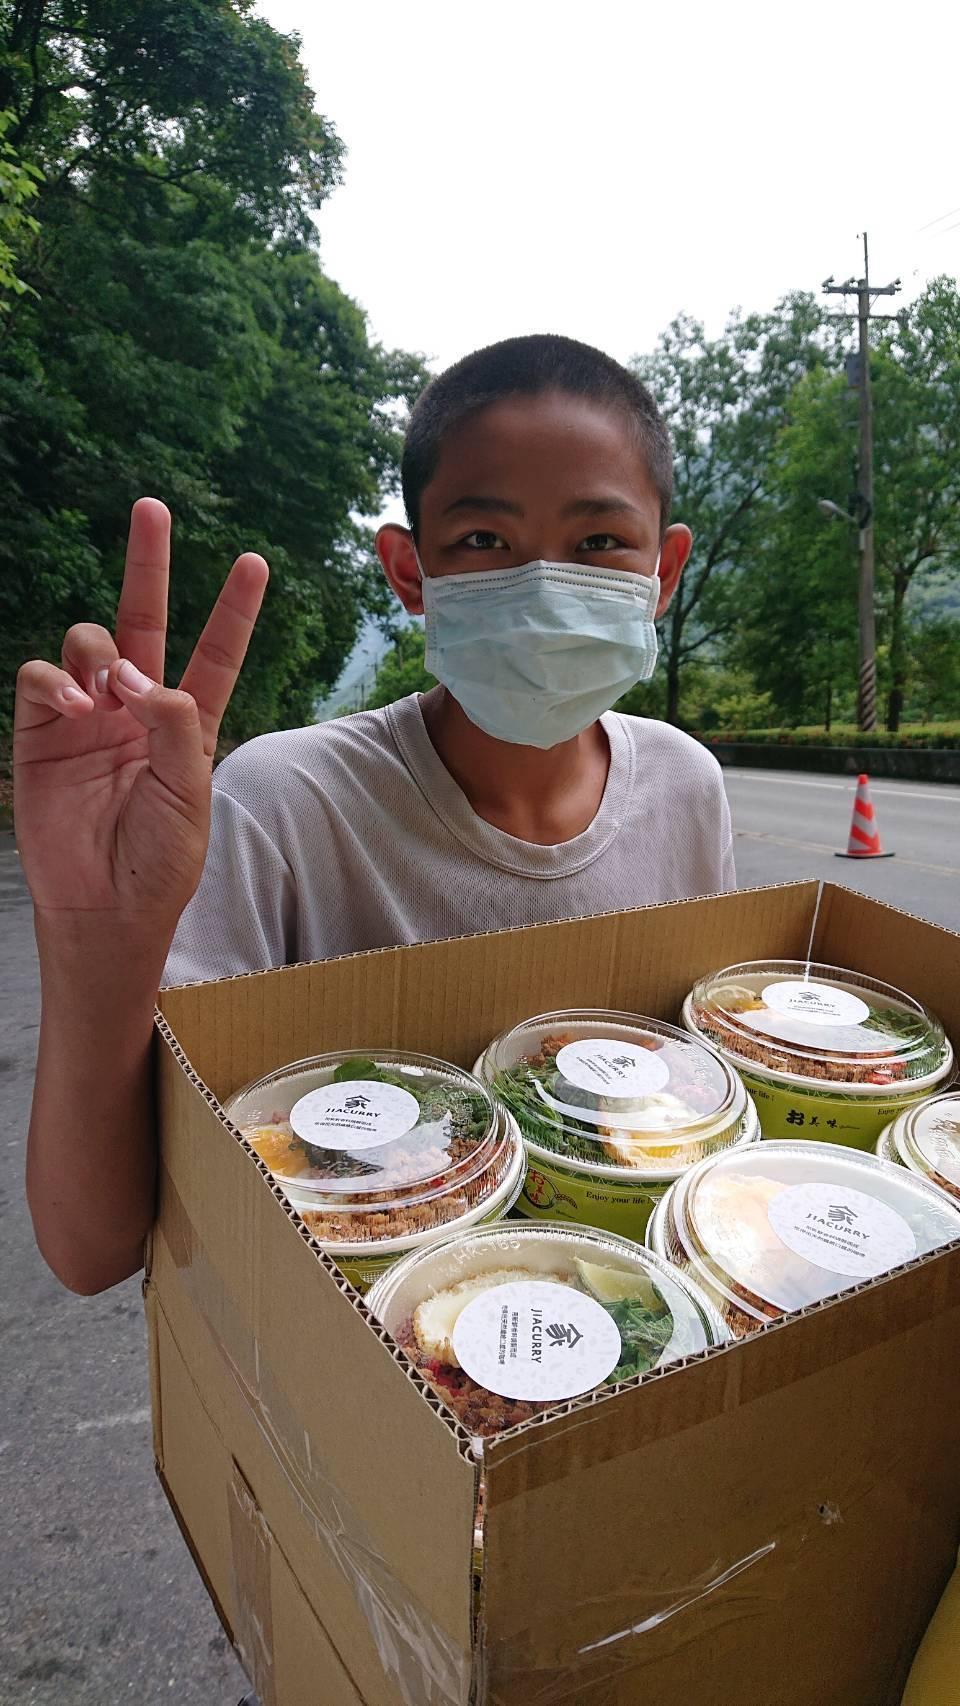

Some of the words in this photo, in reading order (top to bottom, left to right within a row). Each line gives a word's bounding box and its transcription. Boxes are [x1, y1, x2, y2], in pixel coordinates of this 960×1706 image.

[788, 998, 836, 1008] JIACURRY
[593, 1054, 629, 1079] JIACURRY
[325, 1107, 382, 1118] JIACURRY
[586, 1190, 610, 1203] Enjoy
[611, 1196, 630, 1205] your
[632, 1196, 645, 1204] life
[805, 1213, 870, 1239] JIACURRY
[530, 1308, 543, 1364] JIACURRY
